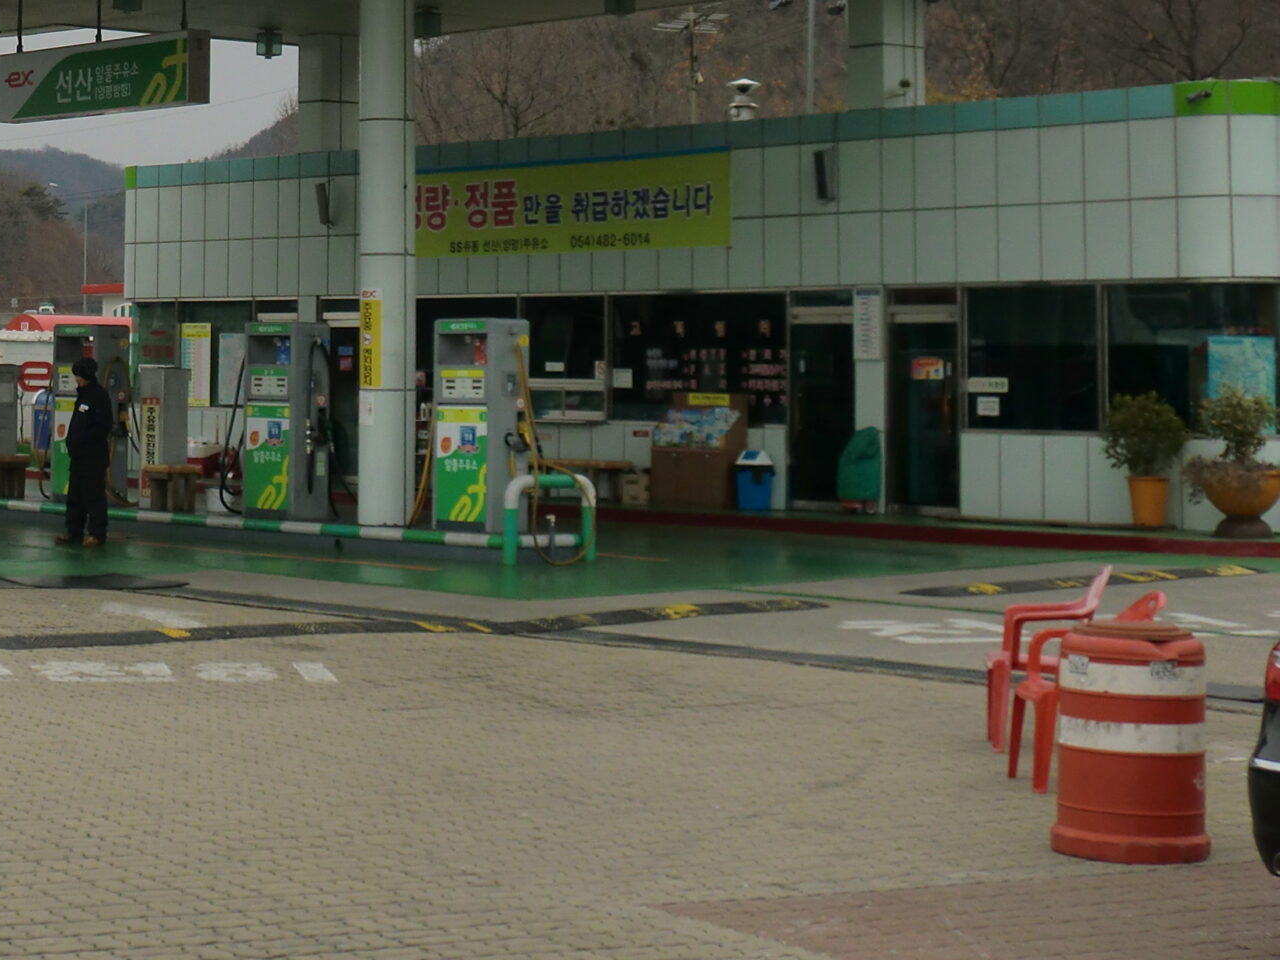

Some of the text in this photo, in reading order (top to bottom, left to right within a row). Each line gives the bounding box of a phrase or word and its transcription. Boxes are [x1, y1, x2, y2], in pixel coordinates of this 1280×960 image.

[4, 69, 35, 89] ex
[55, 67, 94, 103] 선산
[94, 61, 140, 84] 알뜰주유소
[523, 193, 562, 225] 만을
[571, 183, 713, 223] 취급하겠습니다
